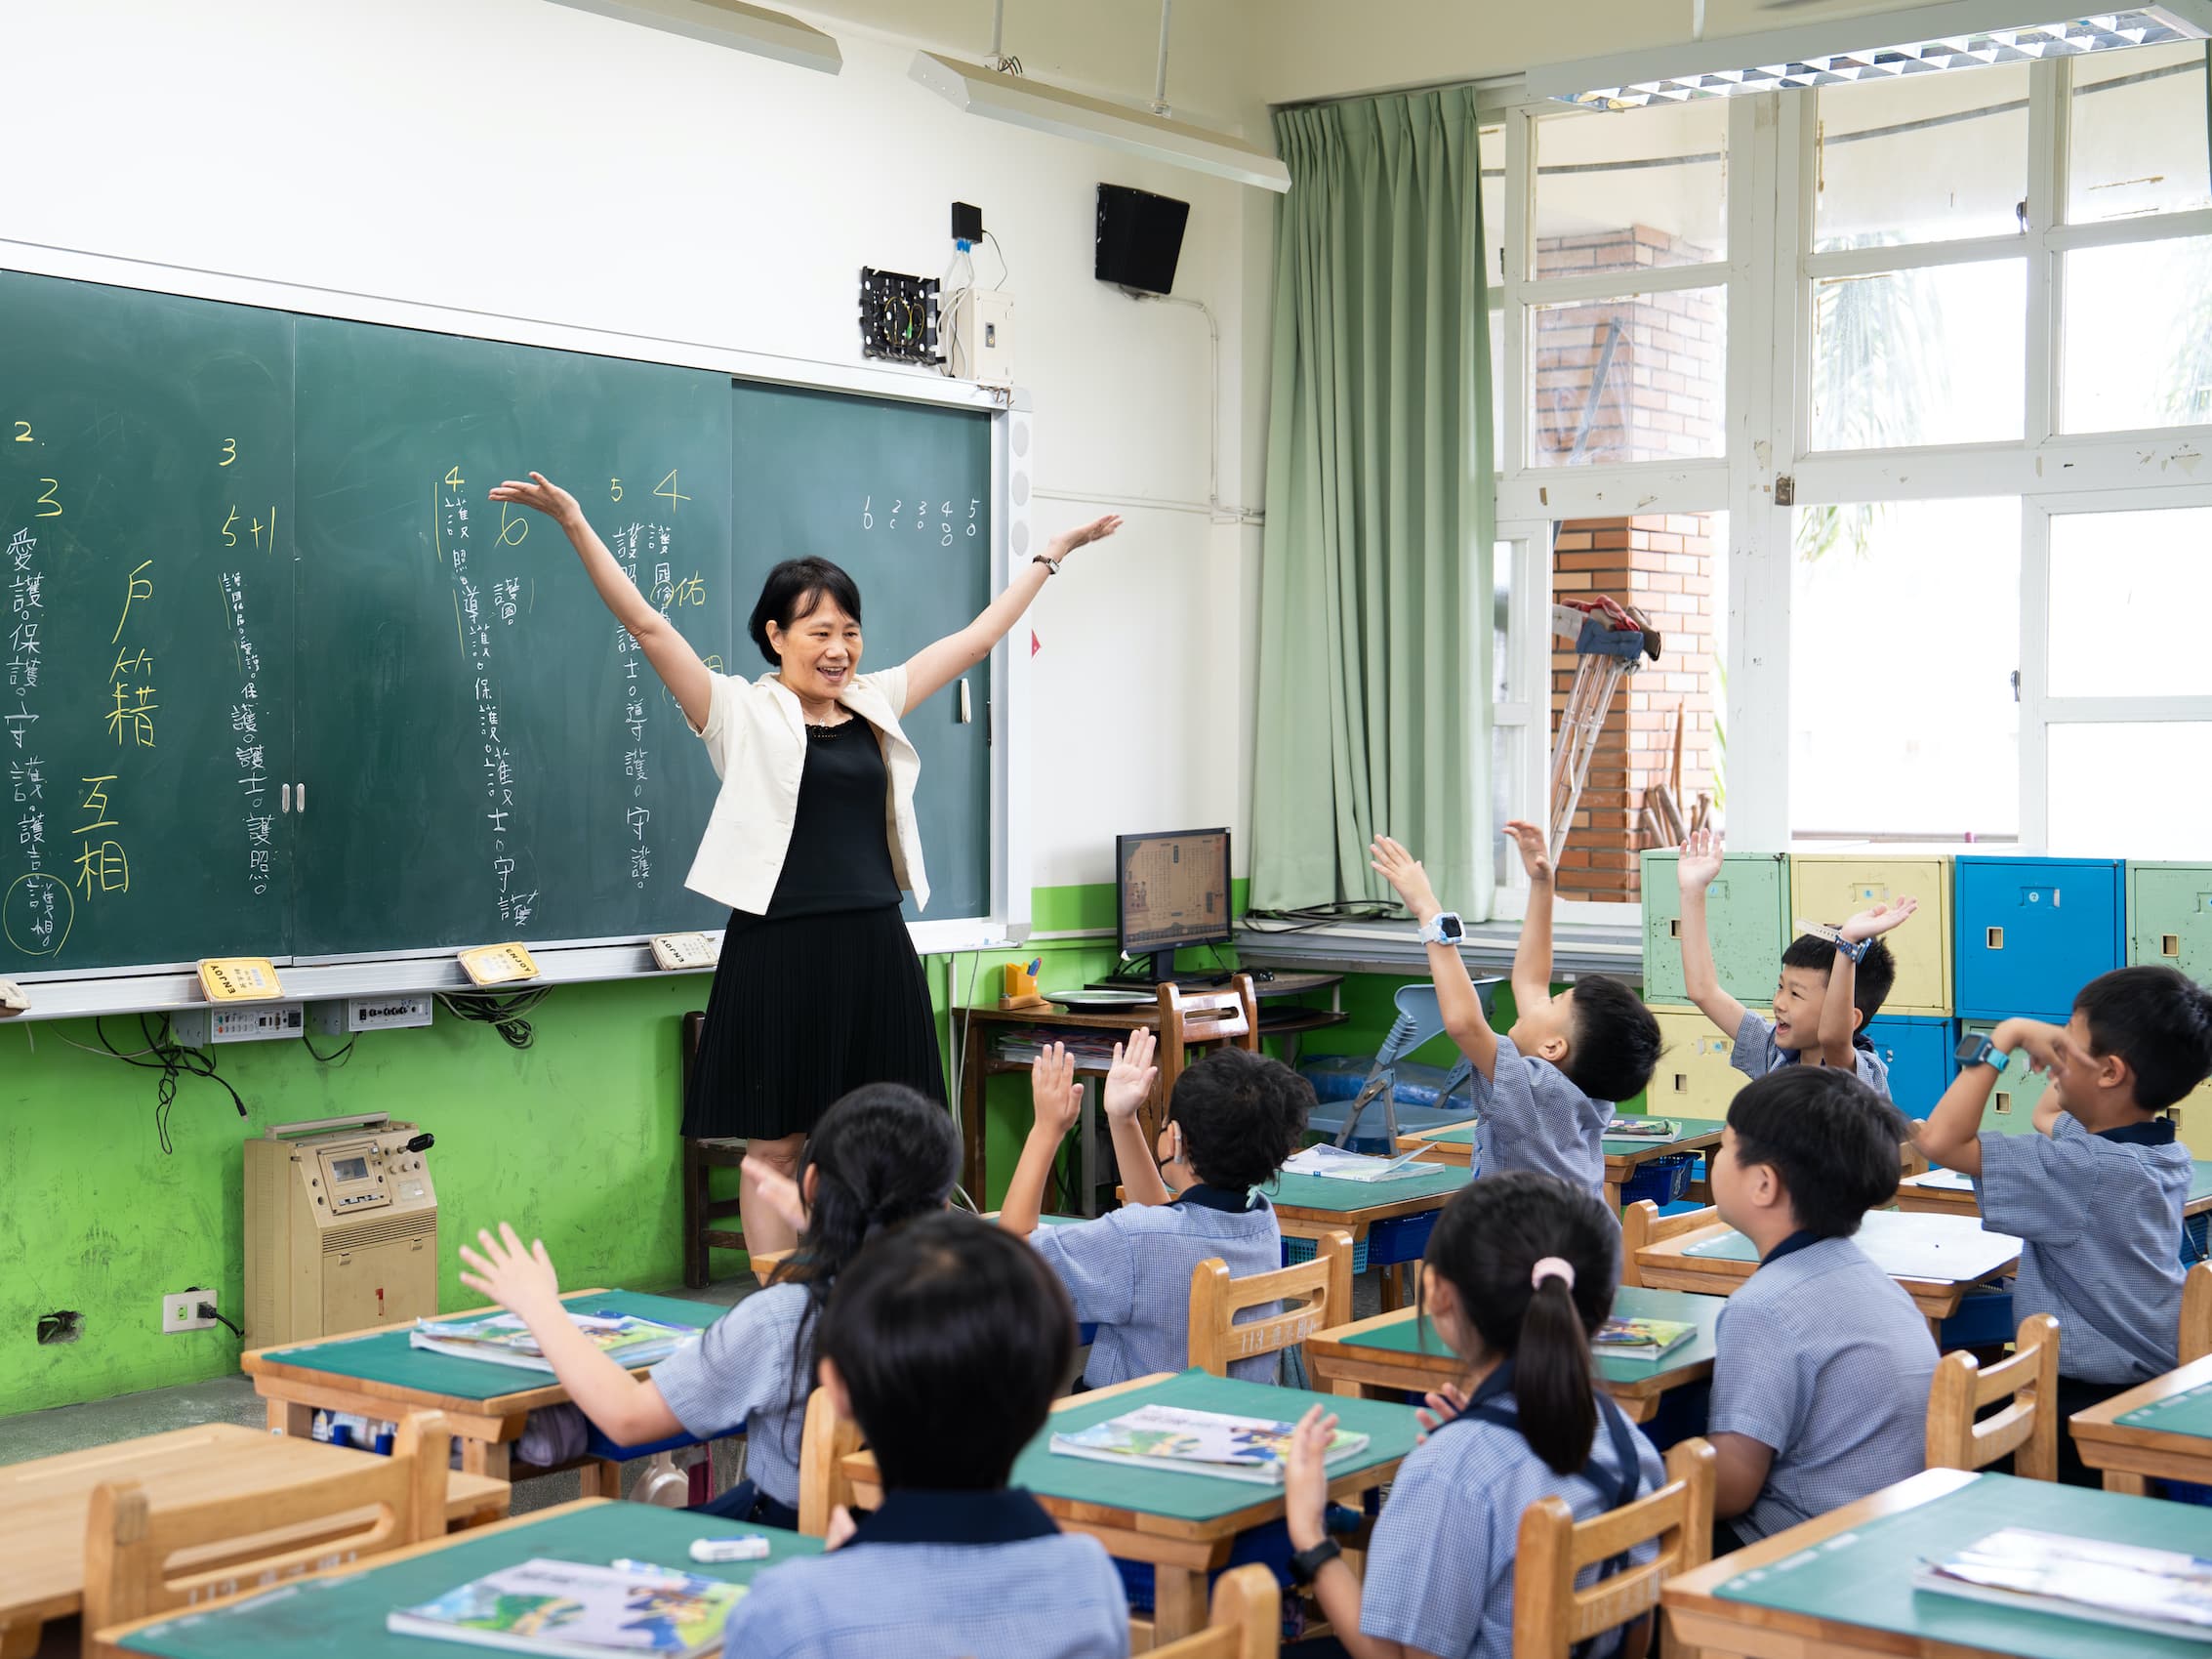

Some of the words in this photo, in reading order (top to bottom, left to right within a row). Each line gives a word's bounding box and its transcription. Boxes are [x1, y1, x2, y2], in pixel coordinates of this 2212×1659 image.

[218, 437, 237, 467] 3
[444, 465, 466, 493] 4
[610, 477, 624, 503] 5
[651, 468, 692, 515] 4
[34, 477, 63, 518] 3
[891, 499, 902, 514] 2
[919, 500, 927, 516] 3
[941, 501, 953, 518] 4
[968, 498, 980, 518] 5
[505, 947, 532, 974] ENJOY
[210, 964, 236, 994] ENJOY
